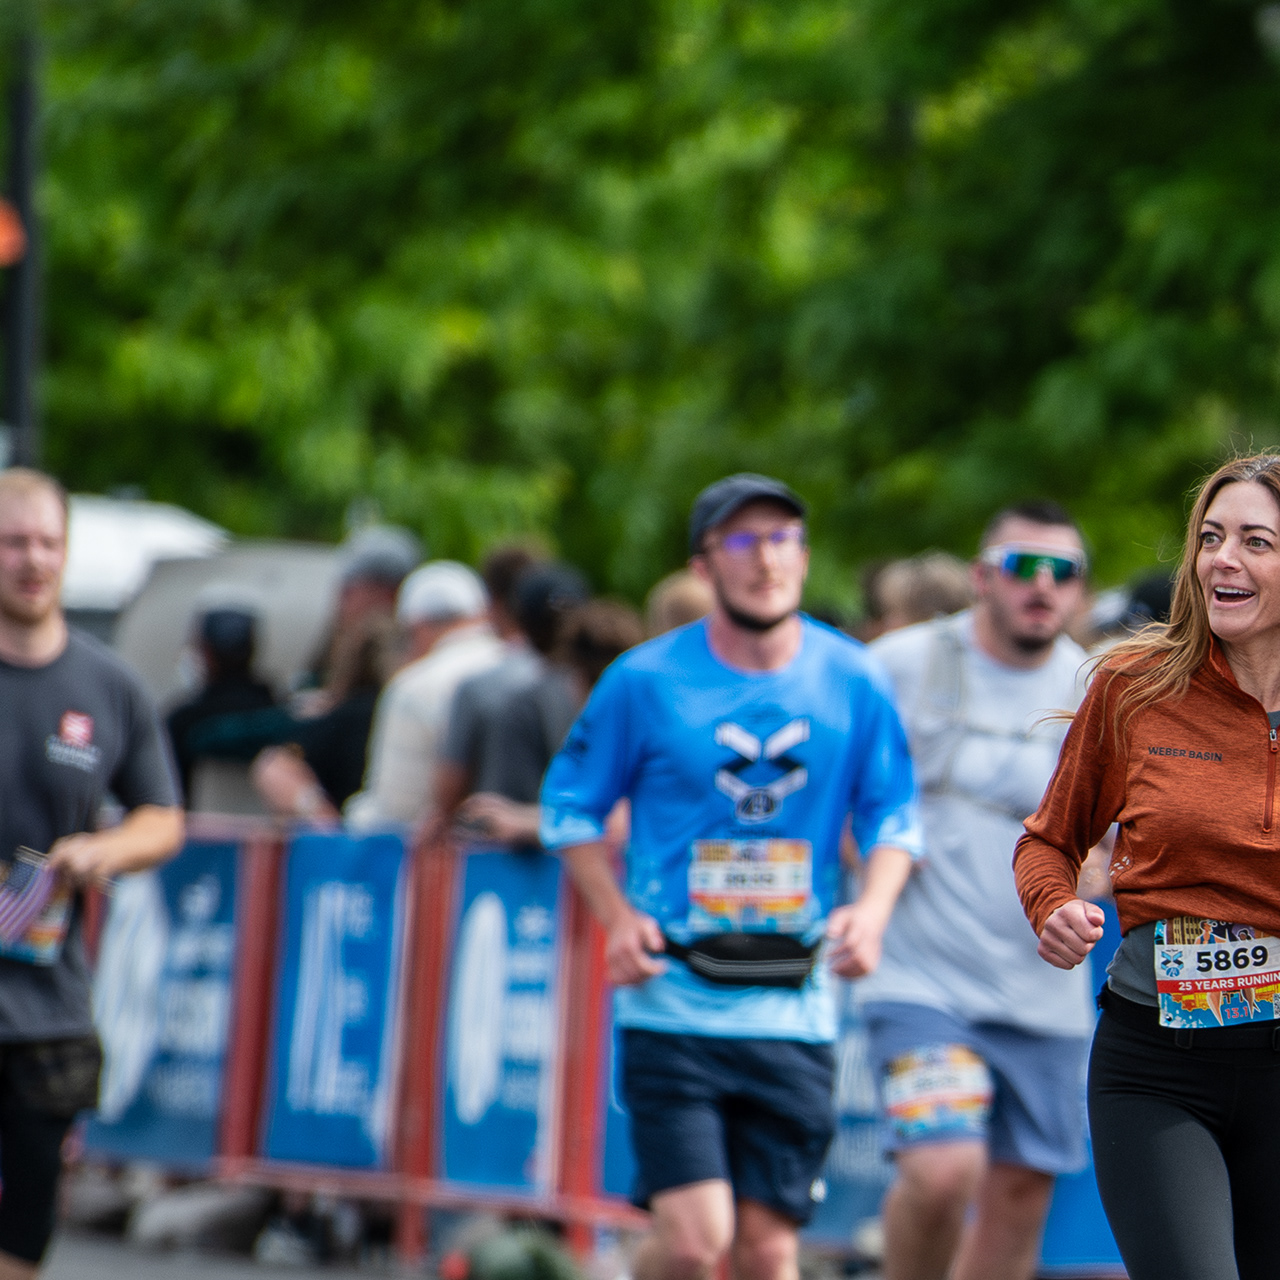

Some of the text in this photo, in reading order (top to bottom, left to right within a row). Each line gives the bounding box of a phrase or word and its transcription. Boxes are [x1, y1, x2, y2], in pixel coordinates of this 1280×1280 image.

[1148, 746, 1223, 762] WEBER BASIN
[1196, 945, 1269, 973] 5869
[1178, 981, 1193, 991] 25
[1194, 978, 1235, 991] YEARS
[1225, 1006, 1249, 1019] 13.1
